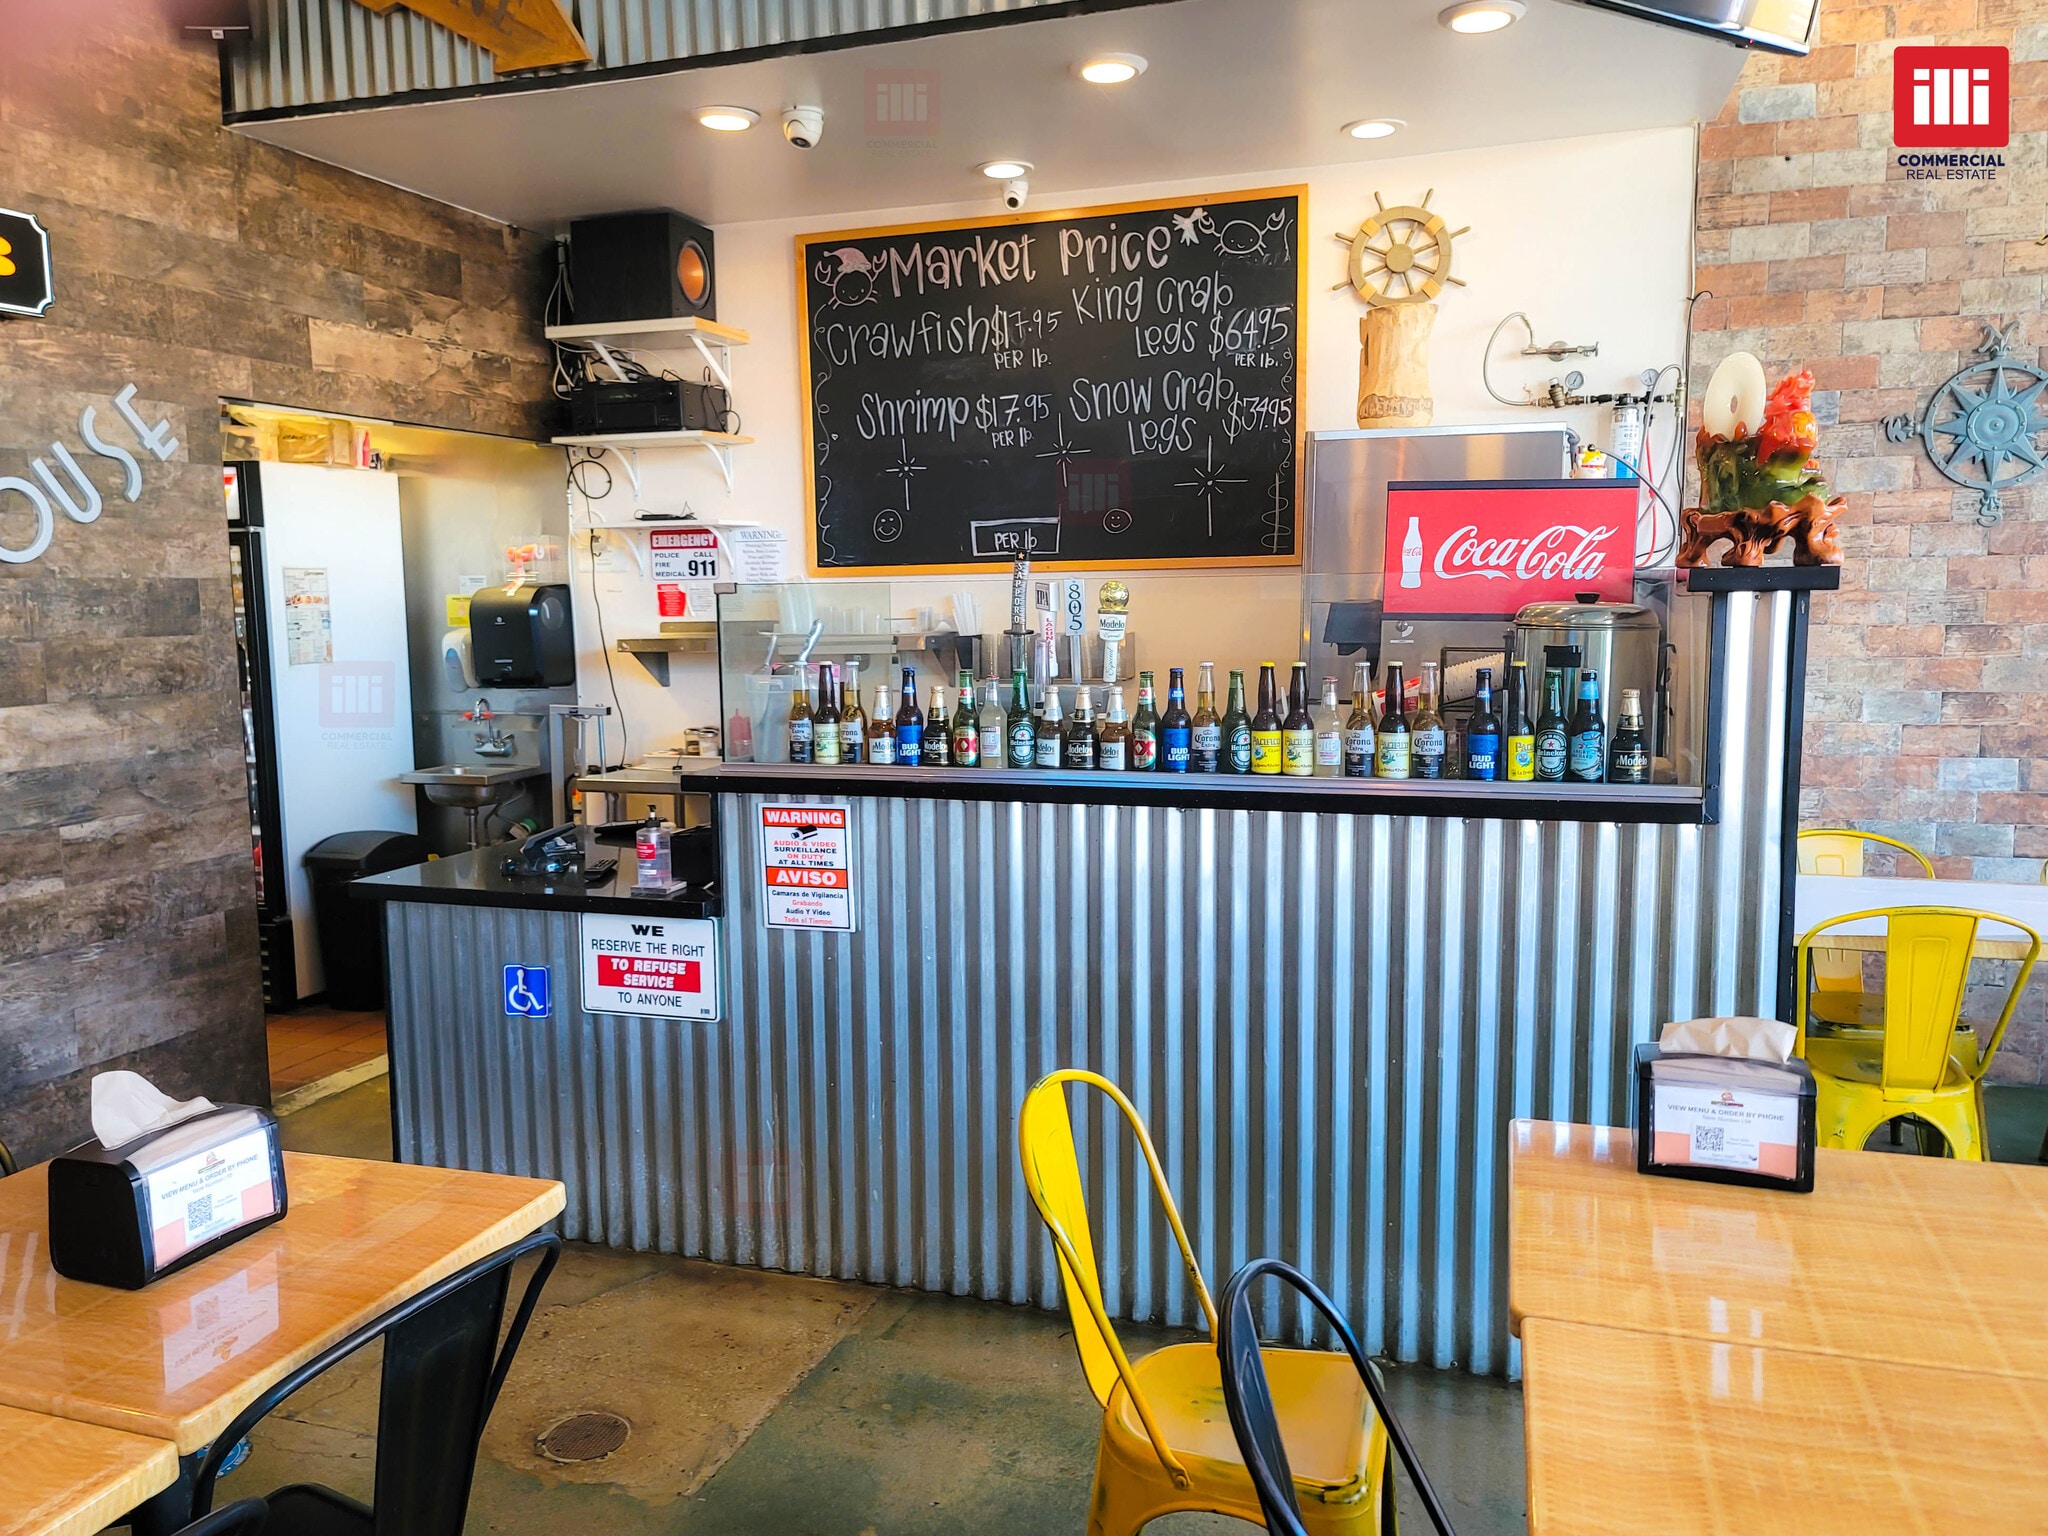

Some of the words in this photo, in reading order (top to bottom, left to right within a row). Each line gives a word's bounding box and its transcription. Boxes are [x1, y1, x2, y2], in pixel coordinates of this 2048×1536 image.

[889, 233, 1037, 299] Market
[1059, 221, 1172, 276] Price
[1072, 275, 1144, 325] King
[1156, 270, 1234, 316] Crab
[826, 304, 990, 367] Crawfish
[991, 304, 1063, 350] $17.95
[1135, 317, 1198, 359] Legs
[1208, 306, 1294, 362] $64.95
[993, 350, 1024, 370] PER
[1234, 353, 1255, 367] PER
[1069, 376, 1152, 423] Snow
[1162, 367, 1235, 413] Crab
[856, 389, 970, 443] Shrimp
[975, 393, 1053, 433] $17.95
[991, 429, 1015, 449] PER
[1128, 413, 1197, 456] Legs
[652, 533, 716, 547] EMERGENCY
[740, 530, 782, 540] WARNING:
[994, 532, 1019, 551] PER
[1433, 525, 1620, 580] Coca-Cola
[688, 559, 716, 577] 911
[1013, 562, 1024, 624] SAPPORO
[1036, 589, 1050, 607] IPA
[1068, 583, 1083, 631] 805
[1099, 619, 1125, 629] Modelo
[1344, 737, 1371, 746] Corona
[1414, 737, 1443, 746] Corona
[1469, 761, 1496, 769] LIGHT
[1616, 754, 1648, 766] Modelo
[765, 810, 843, 825] WARNING
[774, 846, 837, 854] SURVEILLANCE
[776, 870, 838, 886] AVISO
[771, 890, 800, 898] Camaras
[811, 891, 844, 900] Vigilancia
[785, 907, 804, 915] Audio
[812, 908, 831, 916] Video
[631, 924, 665, 937] WE
[591, 938, 641, 953] RESERVE
[646, 942, 667, 954] THE
[672, 944, 705, 957] RIGHT
[611, 958, 629, 971] TO
[633, 959, 687, 975] REFUSE
[623, 974, 675, 989] SERVICE
[617, 991, 632, 1004] TO
[637, 993, 683, 1008] ANYONE
[1718, 1109, 1745, 1117] ORDER
[1757, 1113, 1785, 1121] PHONE
[161, 1188, 179, 1200] VIEW
[179, 1180, 199, 1192] MENU
[204, 1167, 227, 1182] ORDER
[227, 1164, 236, 1172] BY
[236, 1153, 259, 1166] PHONE
